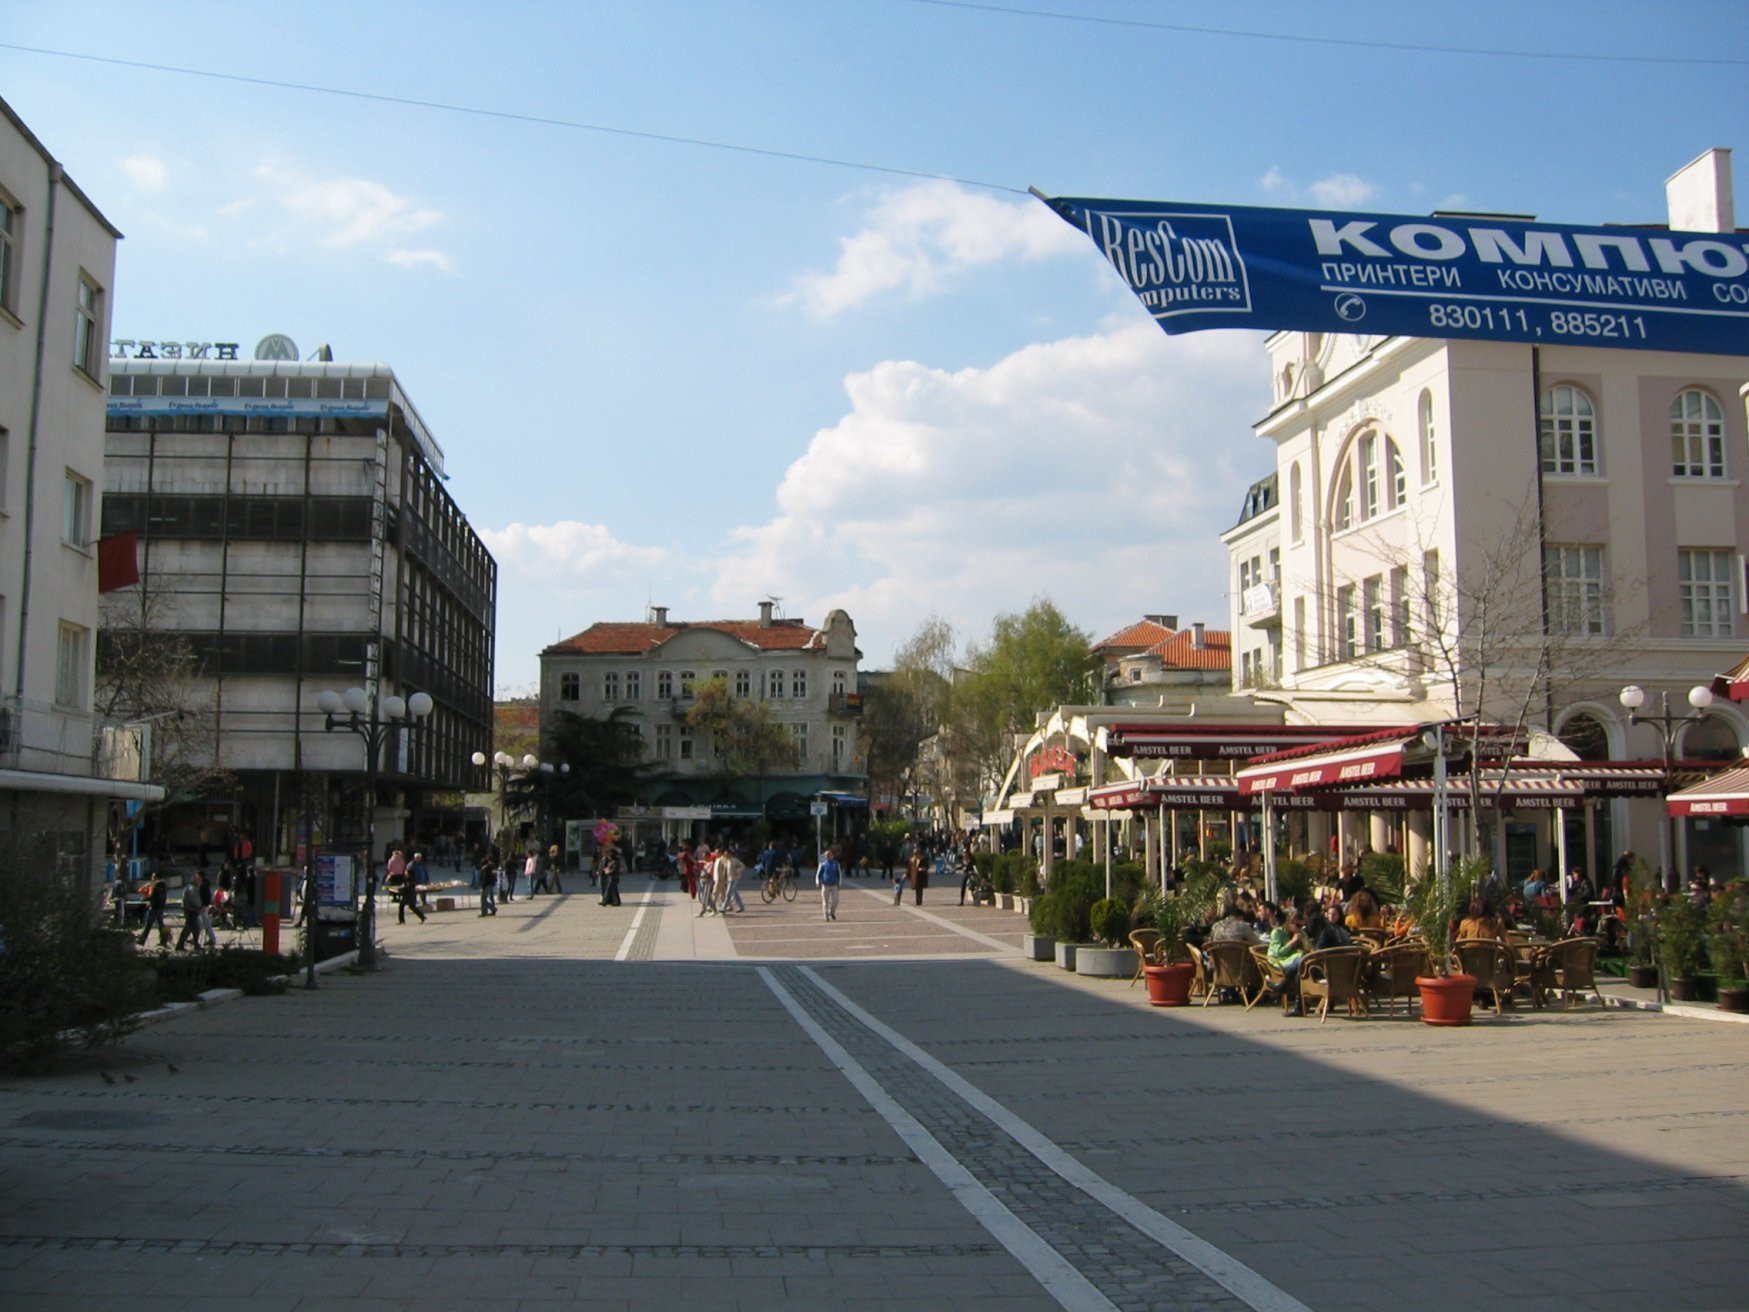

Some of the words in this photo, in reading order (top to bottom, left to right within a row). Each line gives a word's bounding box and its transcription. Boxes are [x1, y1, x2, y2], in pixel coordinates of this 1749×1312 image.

[1100, 214, 1237, 288] ResCom
[1308, 218, 1749, 278] КОМПЮ
[1321, 262, 1462, 288] ПРИНТЕРИ
[1497, 269, 1687, 300] КОНСУМАТИВИ
[1712, 282, 1749, 304] СО
[1550, 311, 1647, 339] 885211
[108, 339, 239, 360] ГАЗИН
[1133, 745, 1168, 755] AMSTEL
[1169, 746, 1192, 755] BEER
[1219, 745, 1253, 755] AMSTEL
[1606, 781, 1637, 791] AMSTEL
[1638, 781, 1659, 791] BEER
[1161, 793, 1198, 804] AMSTEL
[1201, 795, 1224, 805] BEER
[1290, 796, 1315, 806] BEER
[1343, 796, 1381, 807] AMSTEL
[1382, 797, 1407, 807] BEER
[1515, 797, 1551, 807] AMSTEL
[1552, 798, 1575, 808] BEER
